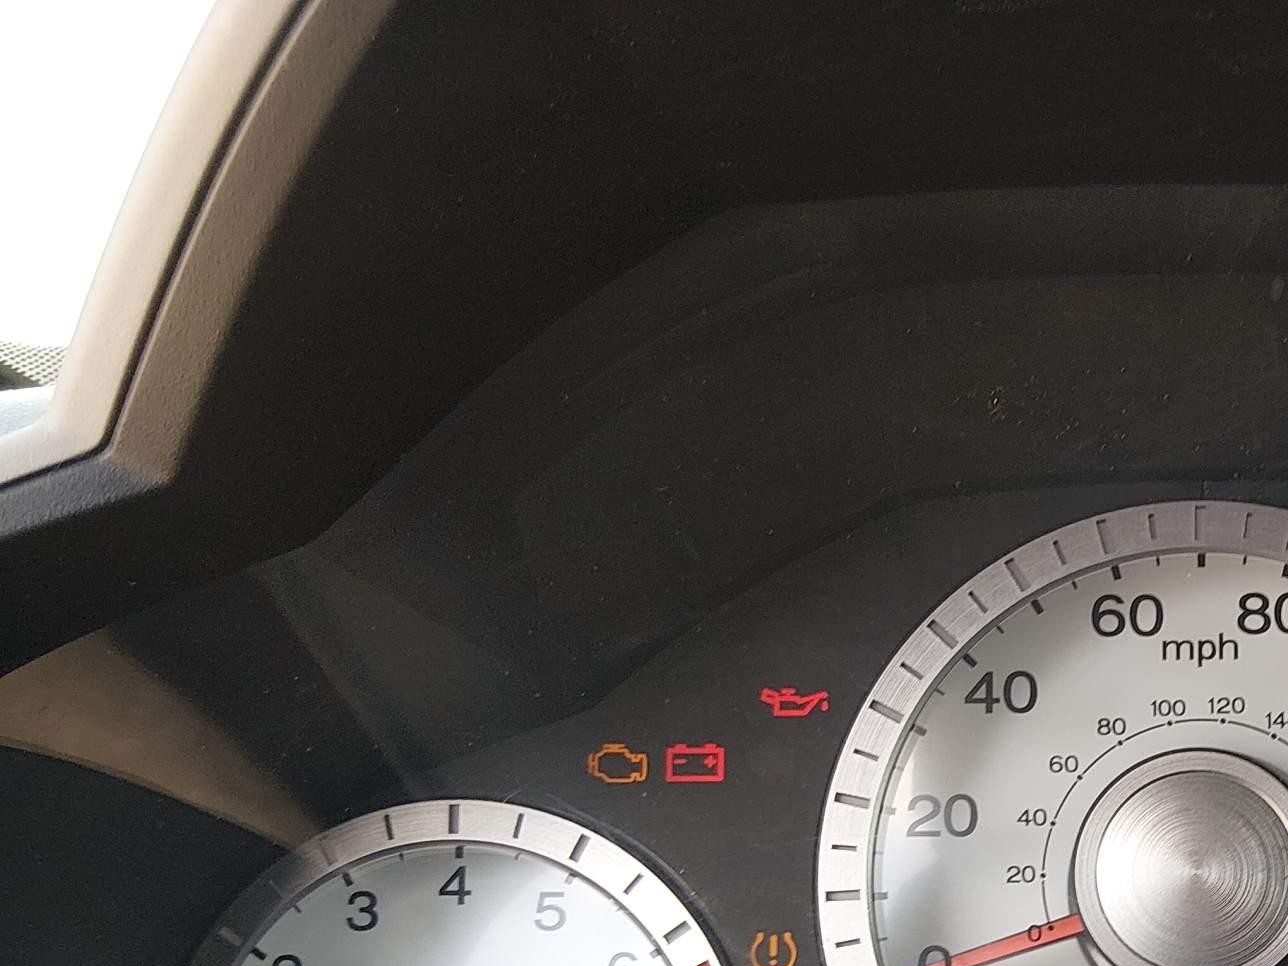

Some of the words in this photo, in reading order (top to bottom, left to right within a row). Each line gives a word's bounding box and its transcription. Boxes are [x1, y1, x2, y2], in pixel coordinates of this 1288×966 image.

[1091, 594, 1164, 637] 60
[1162, 633, 1239, 666] mph
[964, 671, 1039, 714] 40
[1151, 699, 1186, 717] 100
[1208, 697, 1246, 714] 120
[1097, 718, 1127, 736] 80
[1049, 755, 1079, 773] 60
[906, 794, 979, 838] 20
[1017, 809, 1047, 826] 40
[439, 866, 471, 905] 4
[1006, 866, 1036, 883] 20
[346, 891, 379, 931] 3
[535, 891, 566, 931] 5
[1027, 925, 1042, 942] 0
